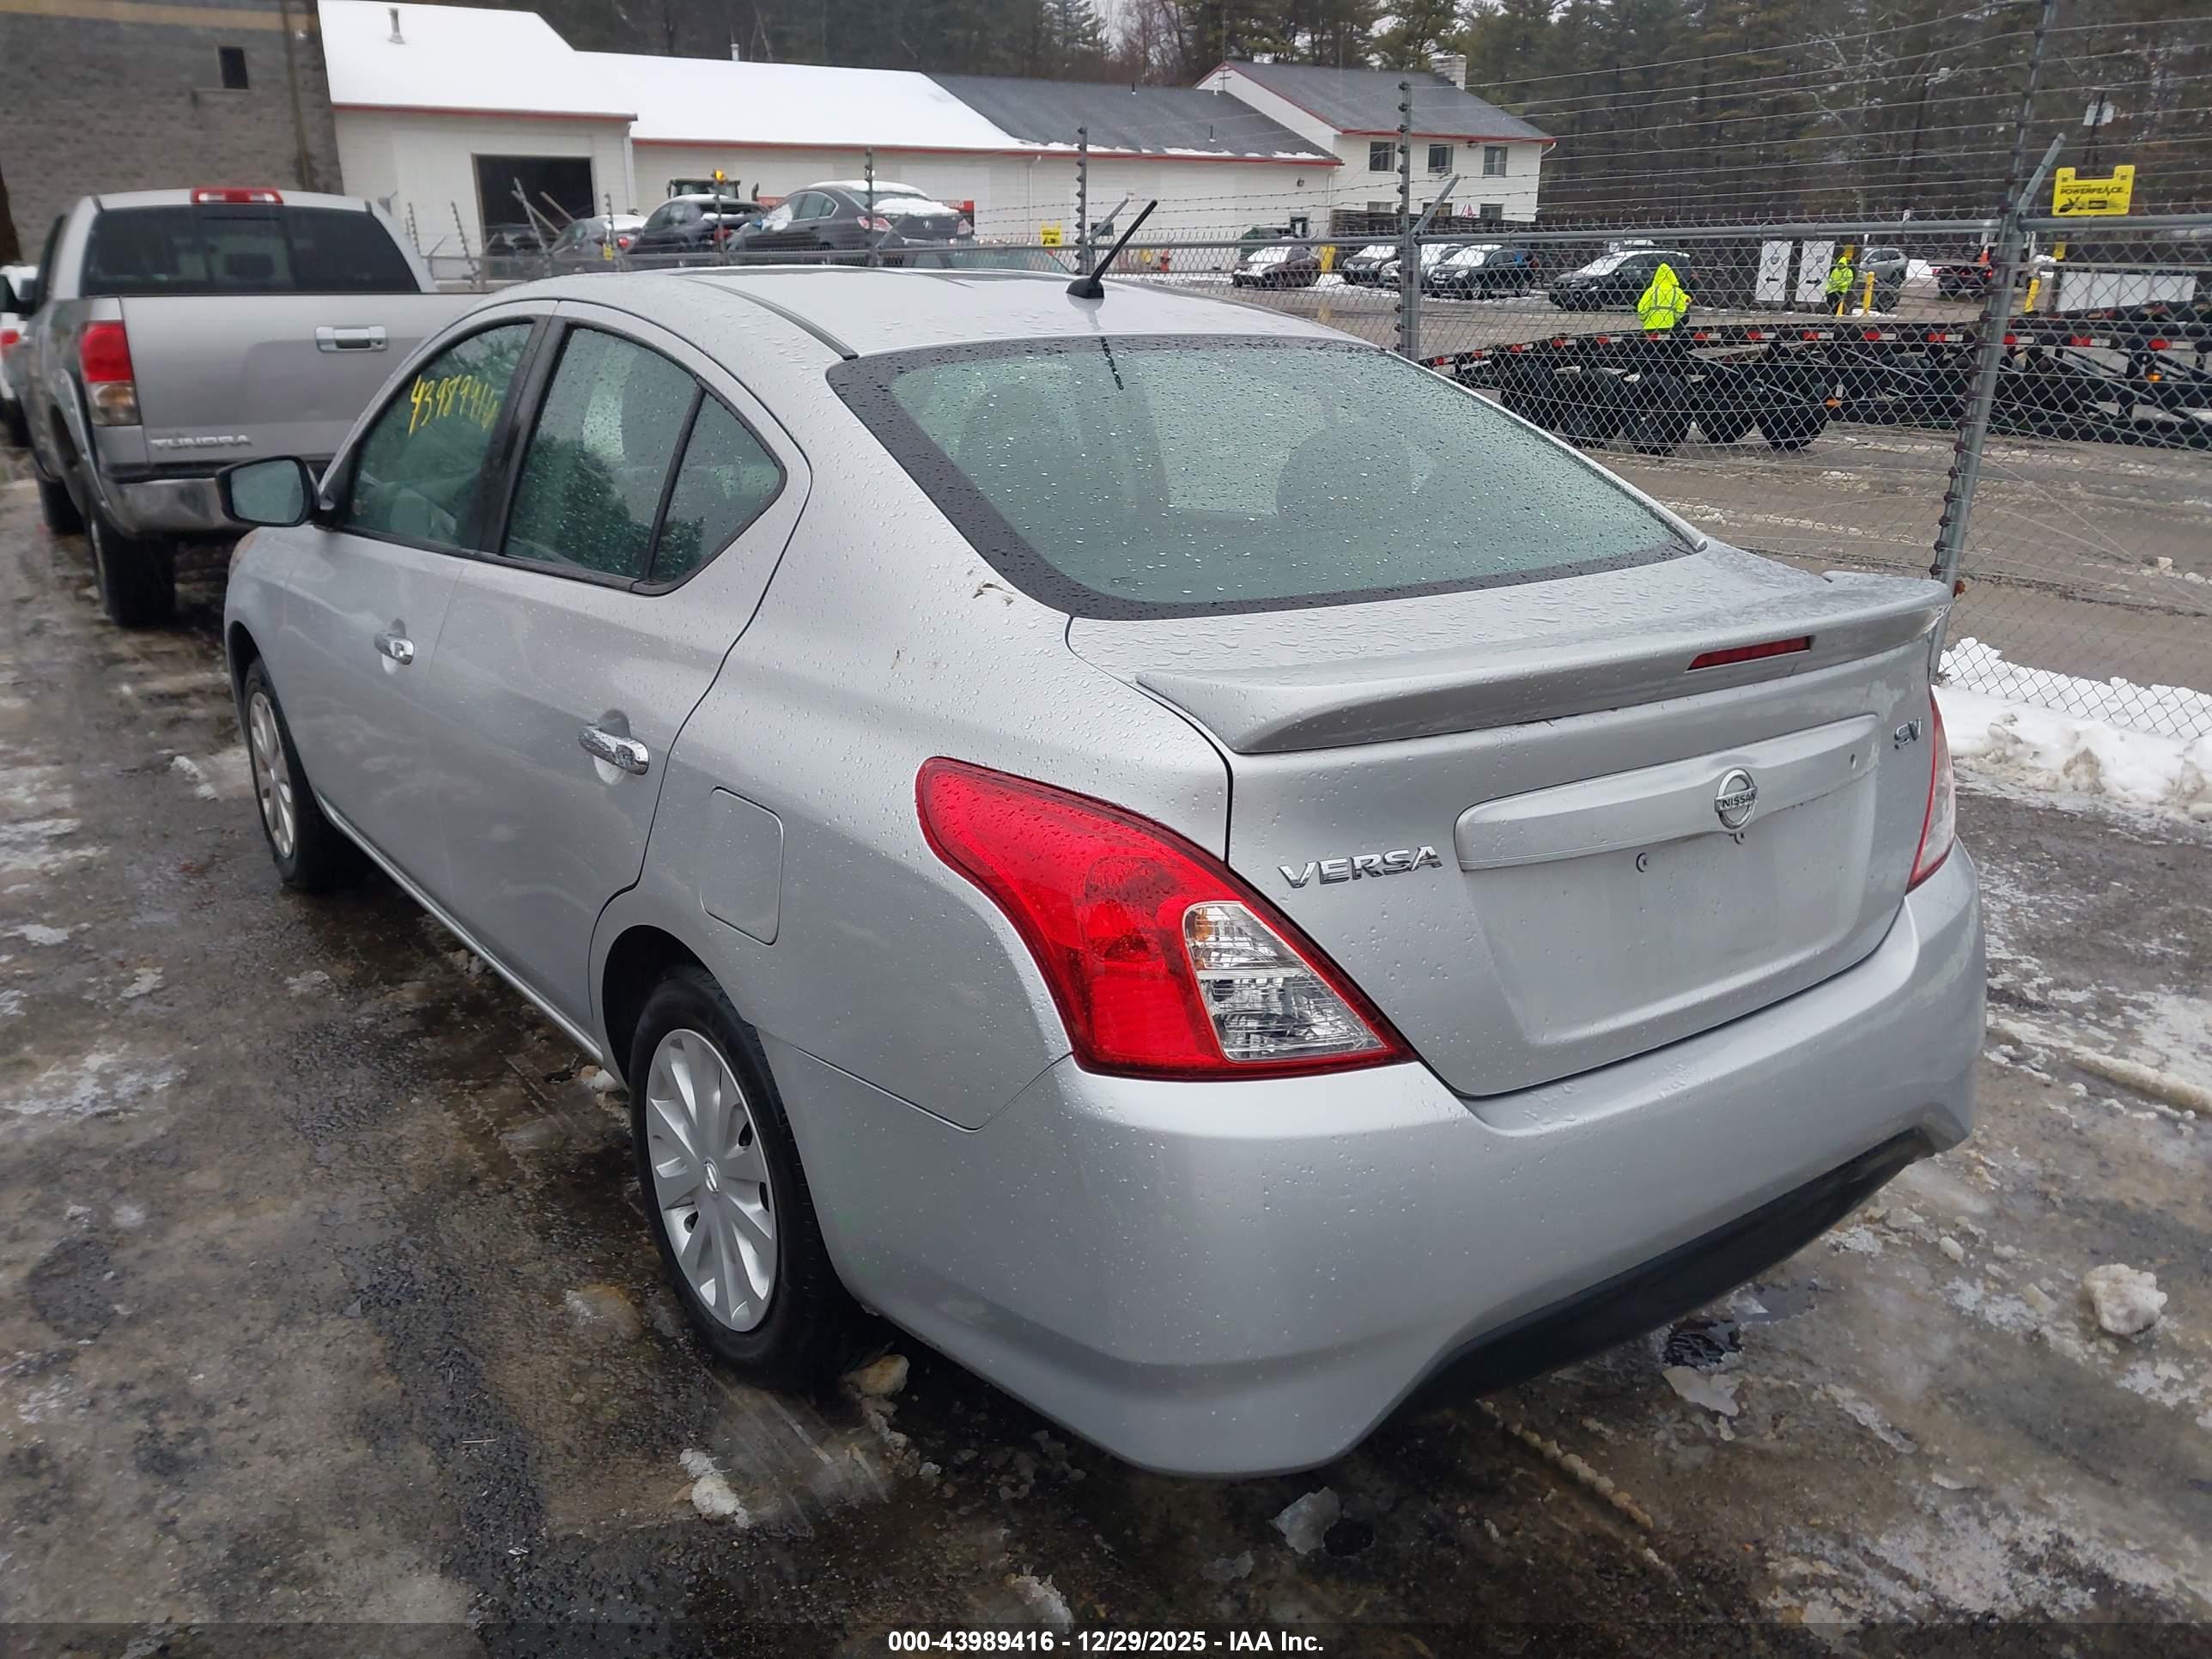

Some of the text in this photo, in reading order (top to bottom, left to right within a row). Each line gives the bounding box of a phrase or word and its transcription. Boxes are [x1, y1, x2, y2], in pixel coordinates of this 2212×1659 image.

[151, 434, 251, 450] TUNDRA
[1894, 716, 1923, 750] SV
[1722, 792, 1755, 808] NISSAN
[1278, 845, 1443, 889] VERSA
